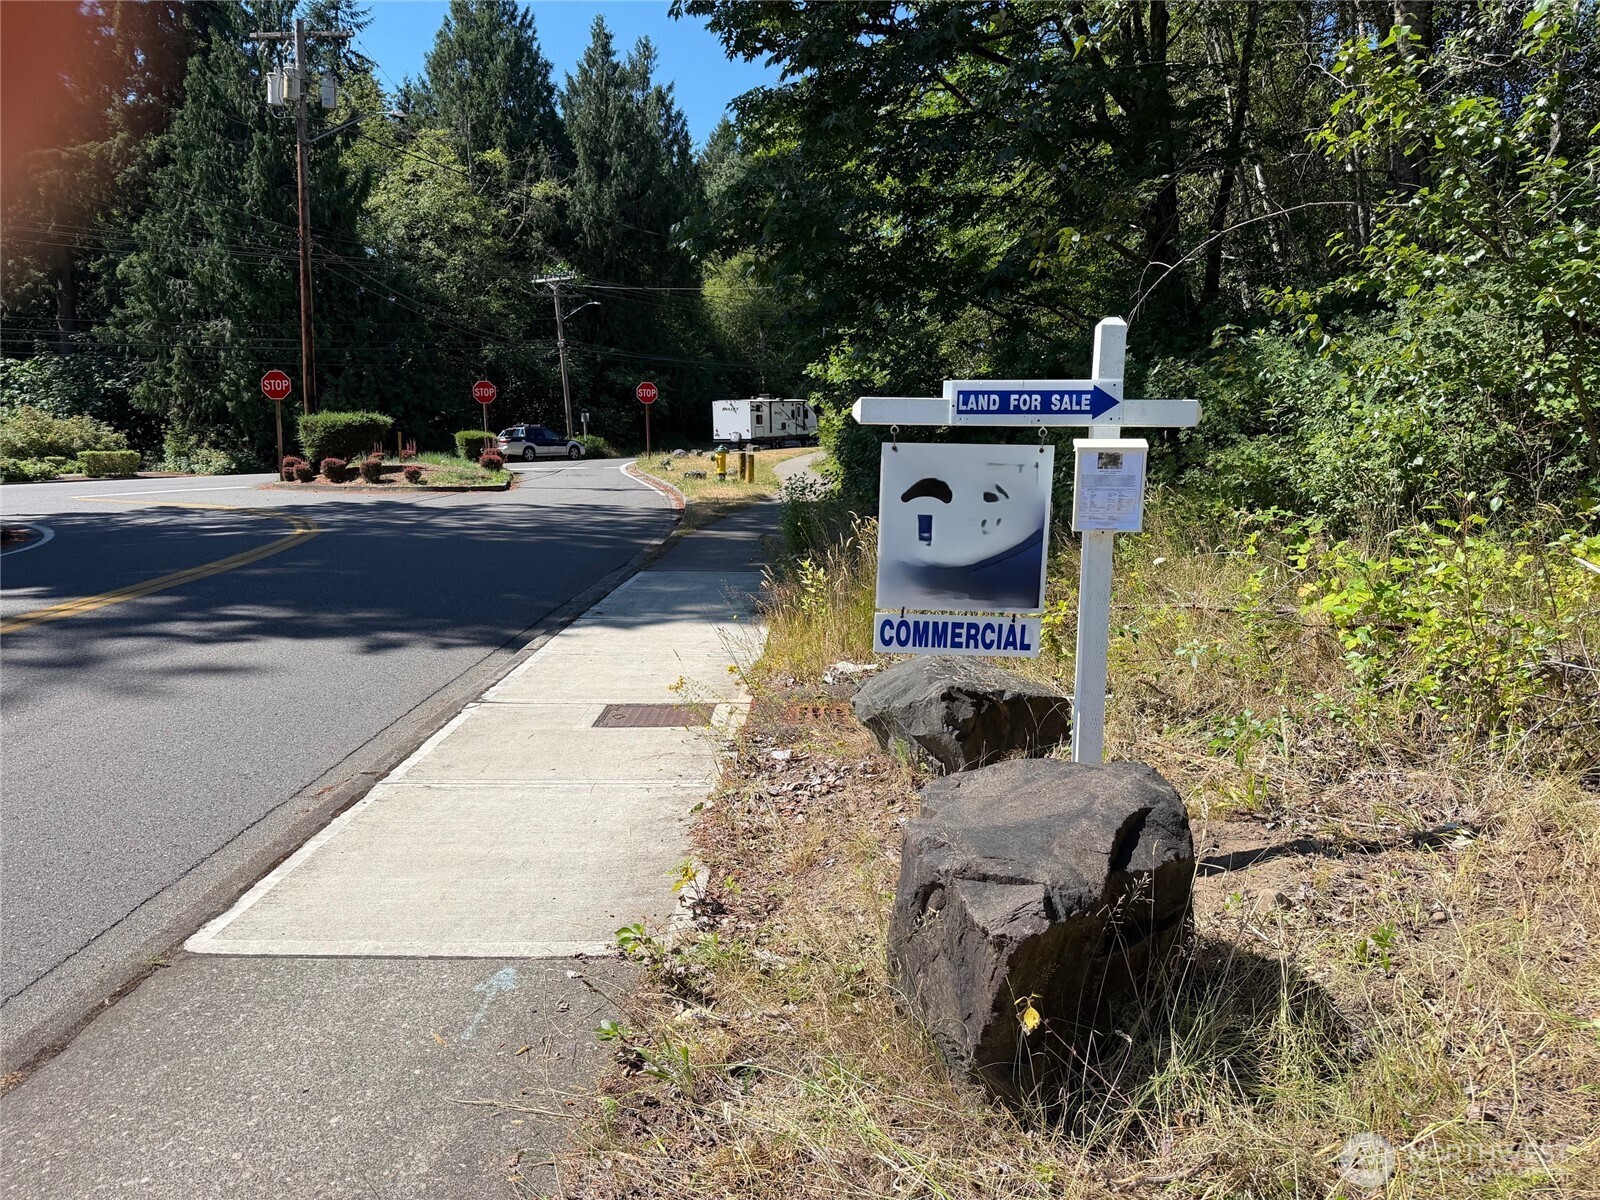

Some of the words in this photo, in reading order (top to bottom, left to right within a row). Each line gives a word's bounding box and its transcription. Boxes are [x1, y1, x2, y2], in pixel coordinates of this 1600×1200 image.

[264, 380, 289, 391] STOP
[474, 388, 495, 397] STOP
[638, 388, 657, 398] STOP
[958, 394, 1000, 411] LAND
[1009, 394, 1042, 411] FOR
[1050, 394, 1092, 411] SALE
[879, 618, 1032, 651] COMMERCIAL
